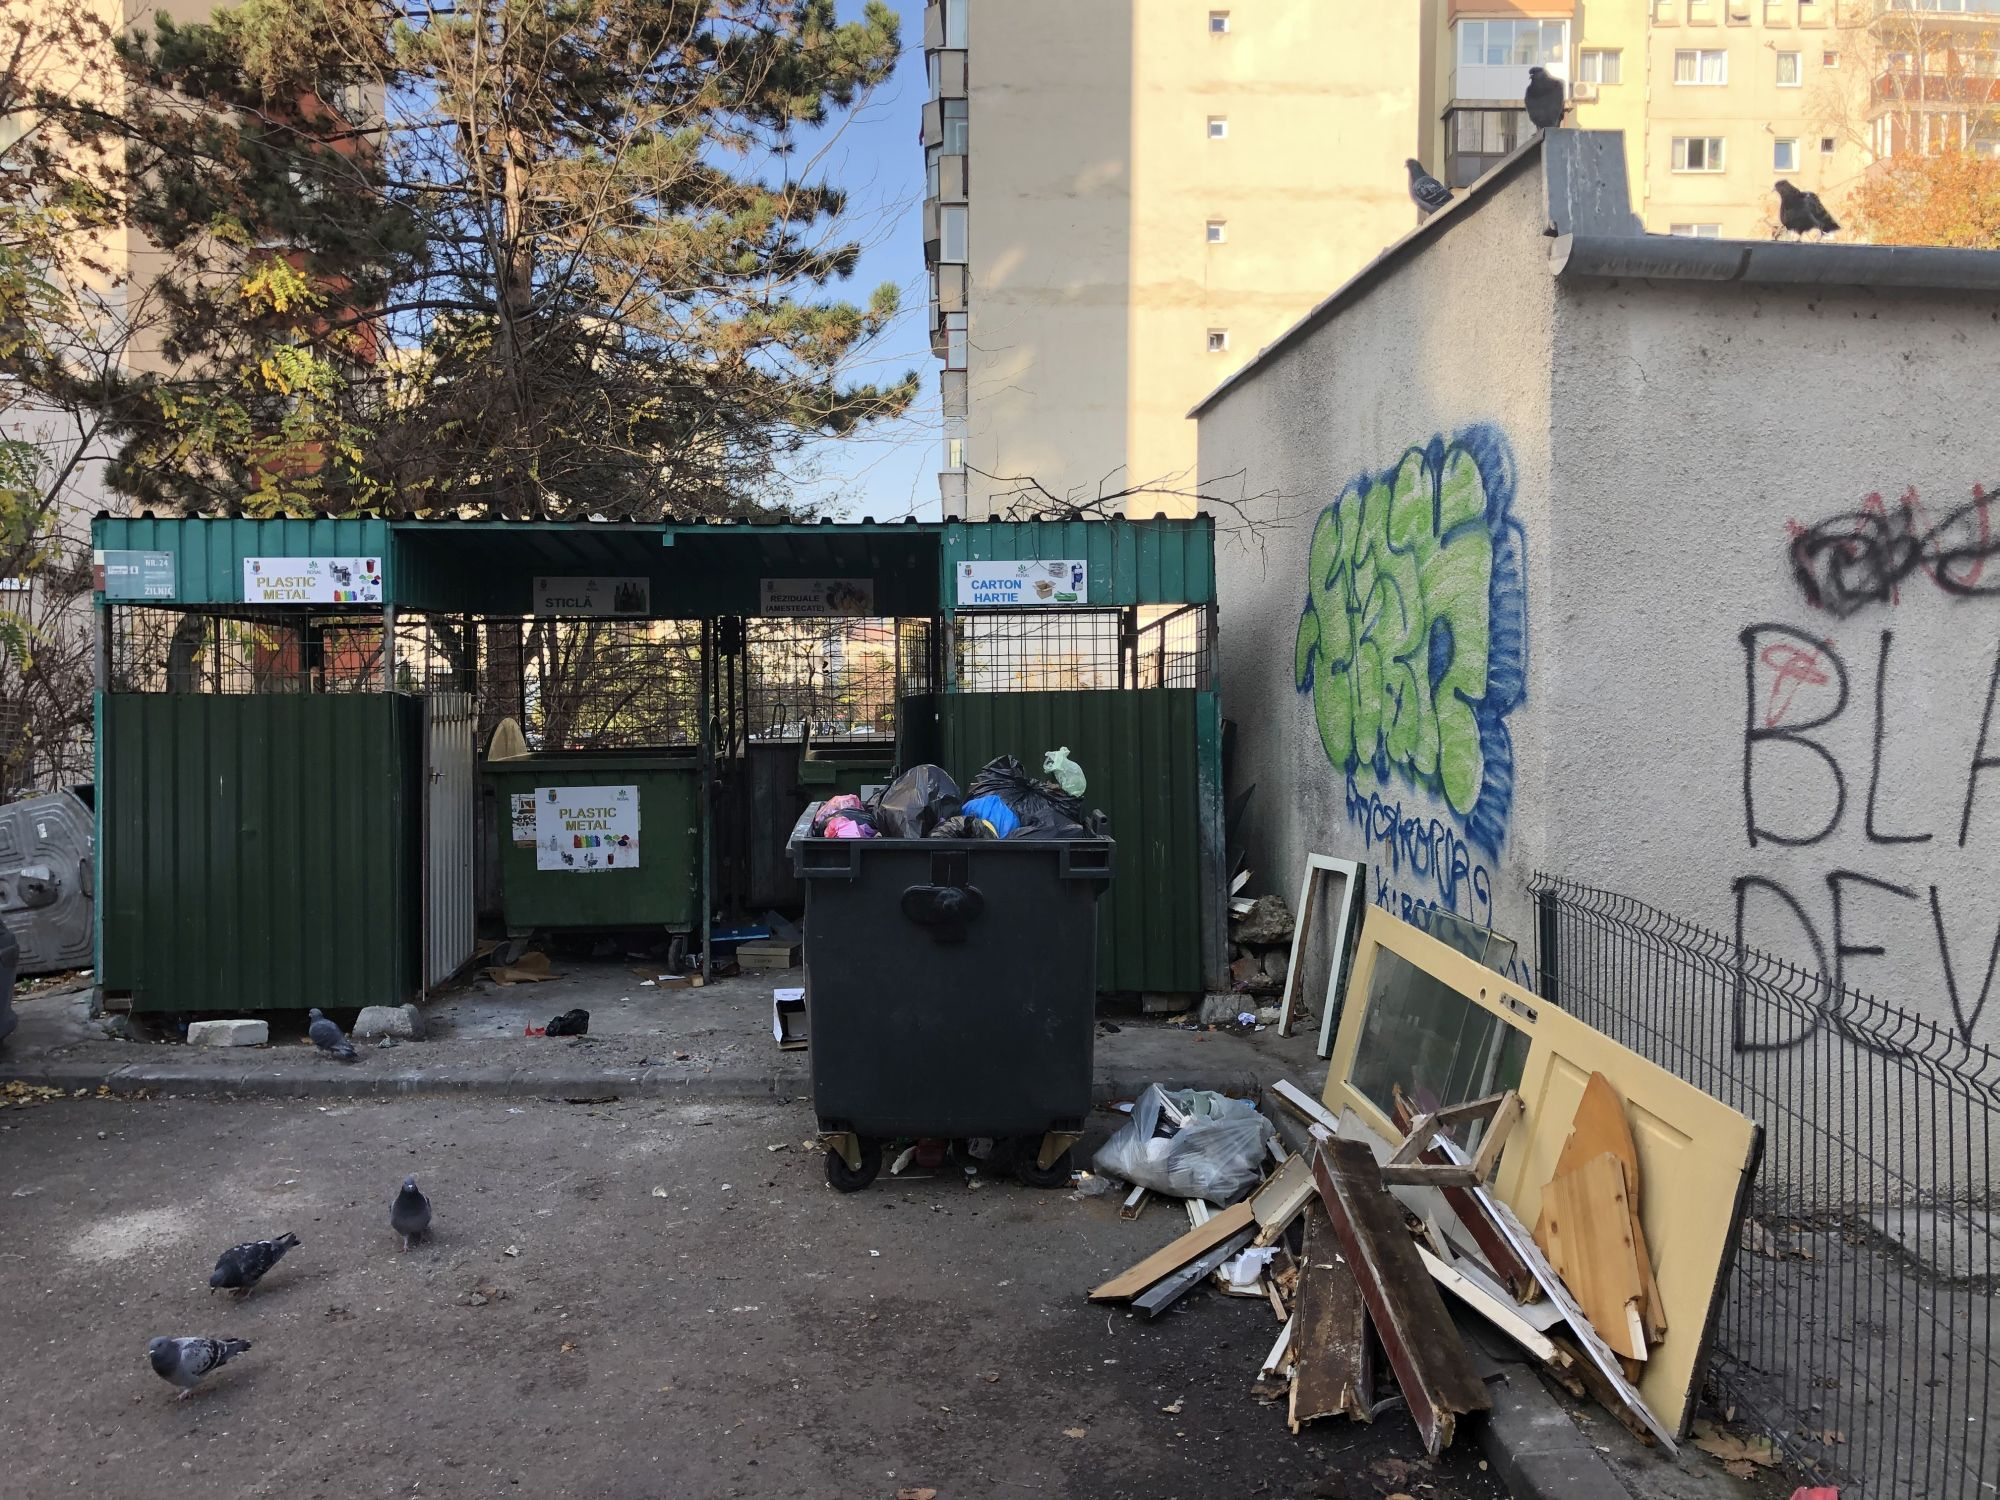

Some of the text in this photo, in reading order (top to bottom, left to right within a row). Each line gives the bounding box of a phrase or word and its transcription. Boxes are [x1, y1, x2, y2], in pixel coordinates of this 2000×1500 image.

[256, 576, 316, 588] PLASTIC
[971, 580, 1022, 589] CARTON
[263, 589, 310, 600] METAL
[770, 595, 821, 603] REZIDUALE
[974, 593, 1018, 603] HARTIE
[765, 605, 825, 613] (AMESTECATE)
[559, 807, 617, 819] PLASTIC
[565, 820, 611, 831] METAL
